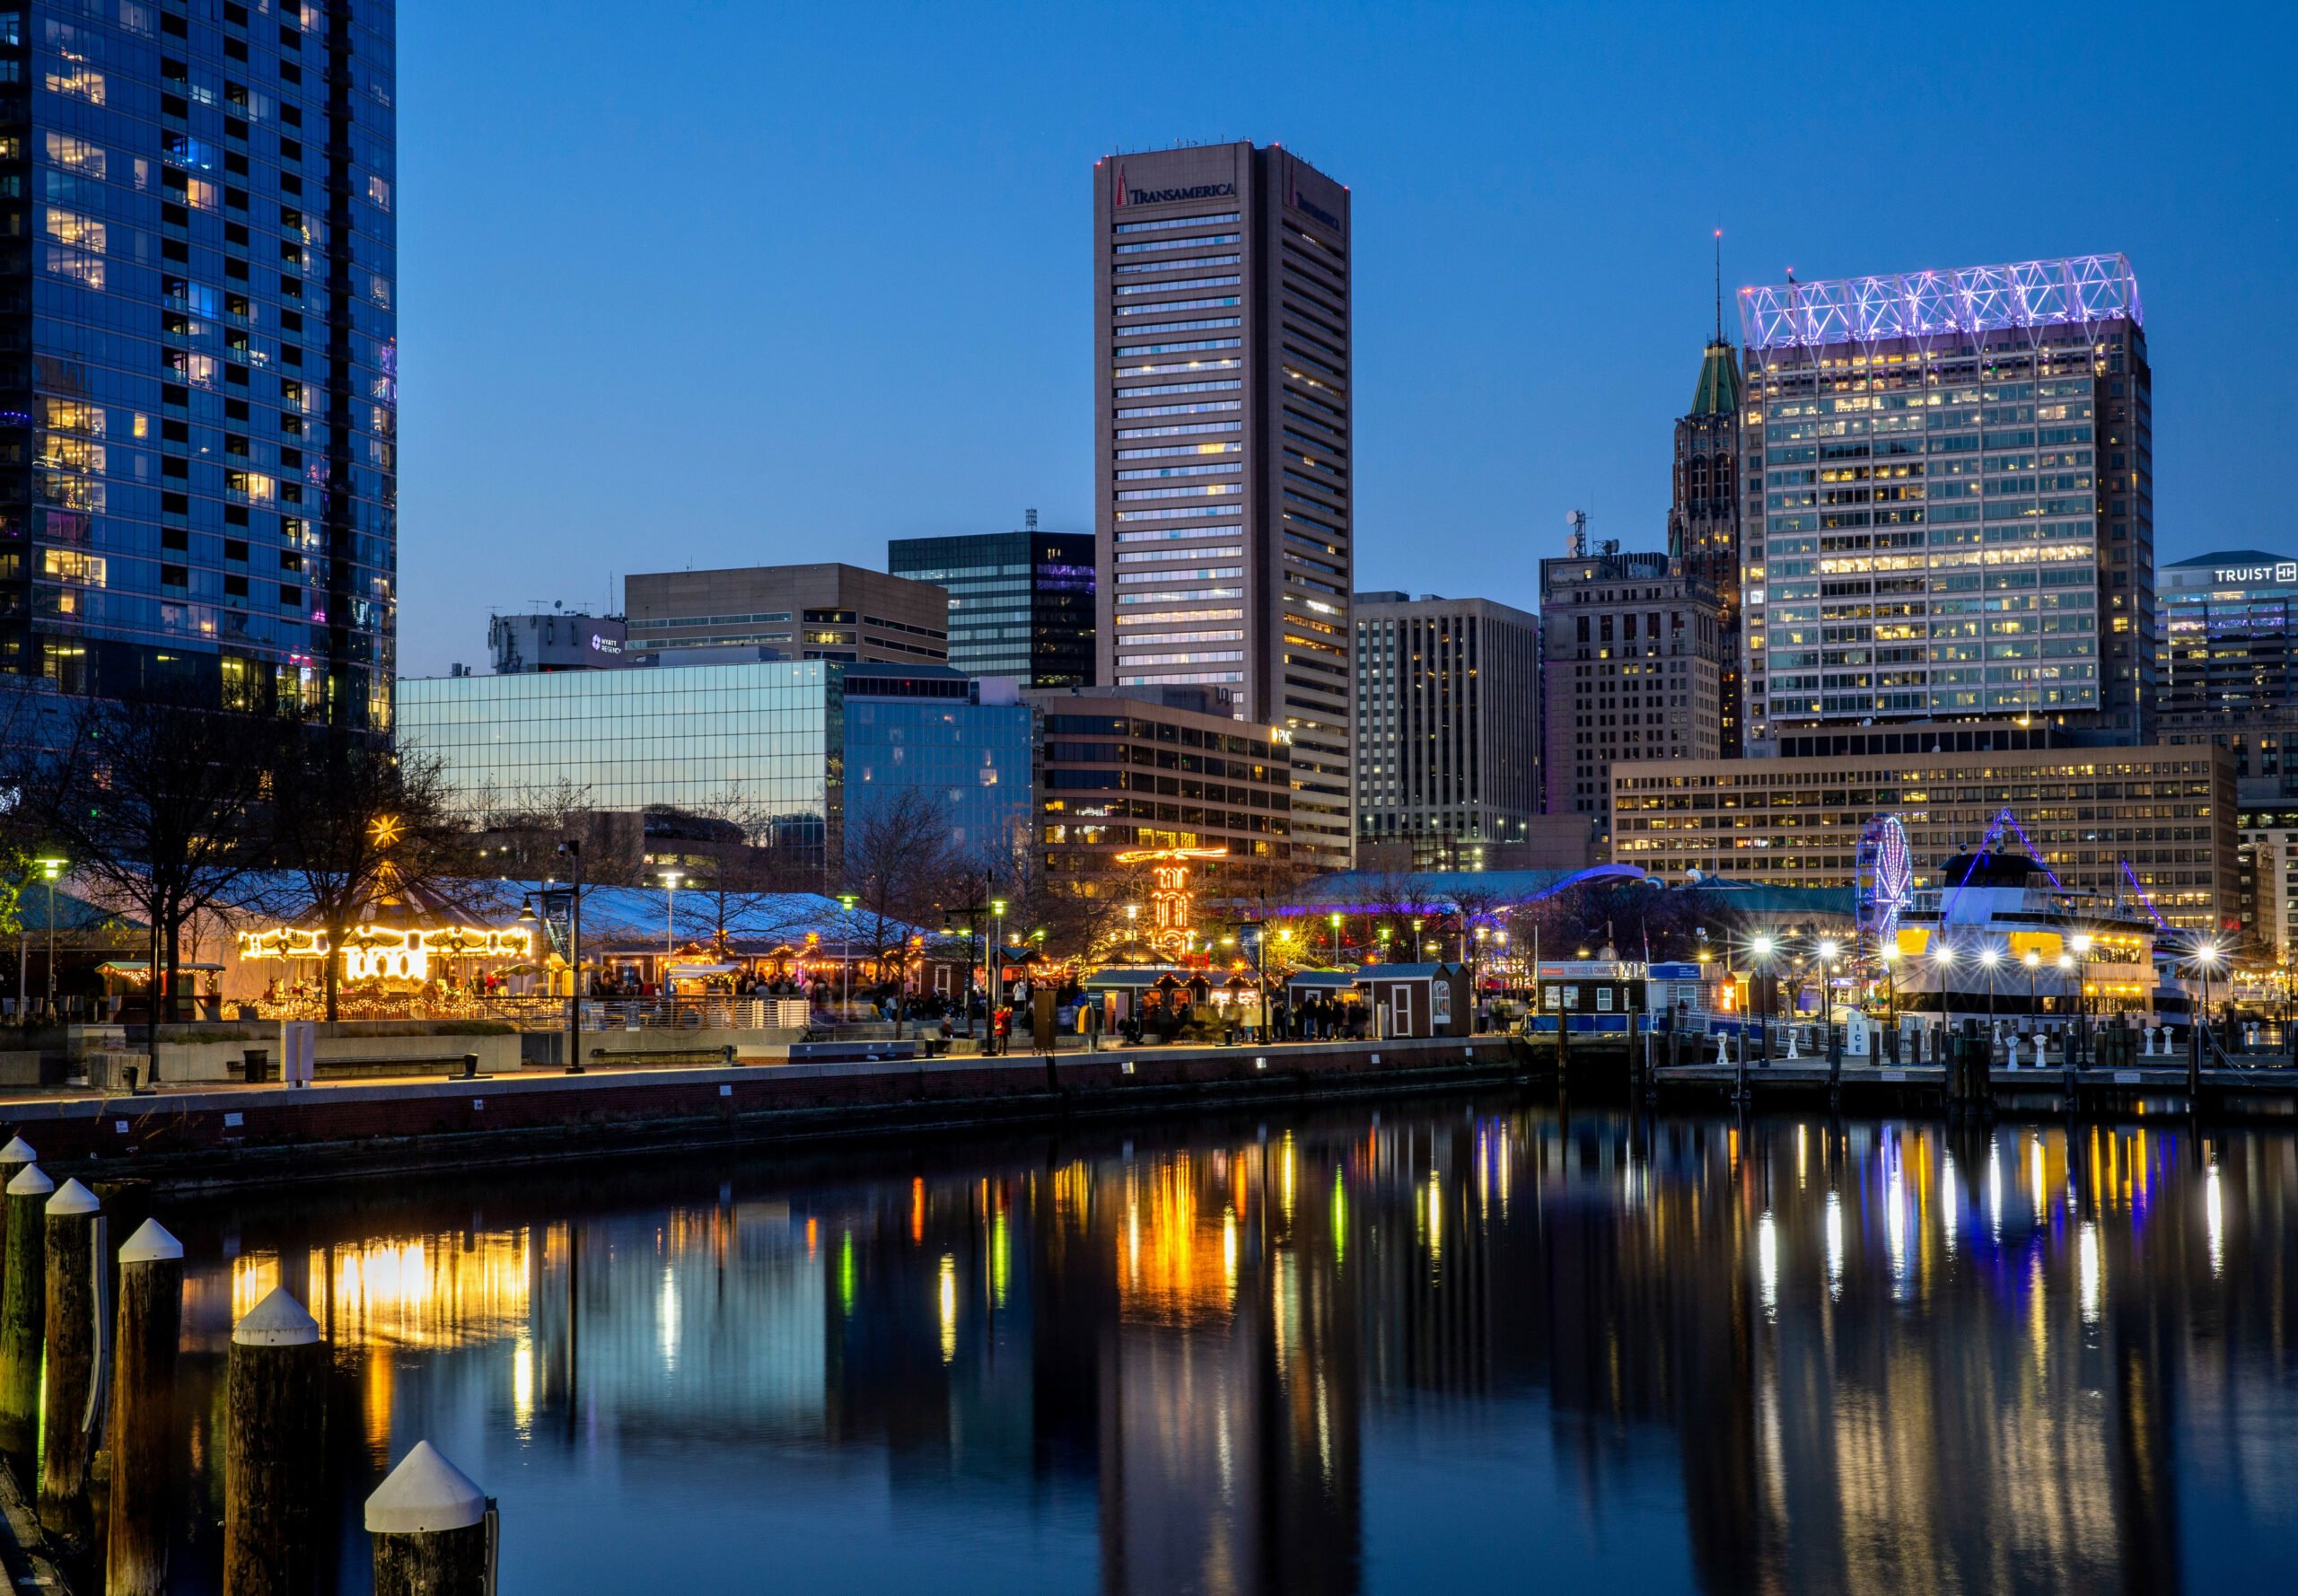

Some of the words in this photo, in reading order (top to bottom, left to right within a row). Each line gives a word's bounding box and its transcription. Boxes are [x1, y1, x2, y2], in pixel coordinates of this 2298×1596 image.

[1130, 183, 1234, 205] TRANSAMERICA
[2215, 567, 2273, 582] TRUIST
[601, 638, 617, 646] HYATT
[601, 645, 622, 654] REGENCY
[1278, 729, 1292, 744] PNC
